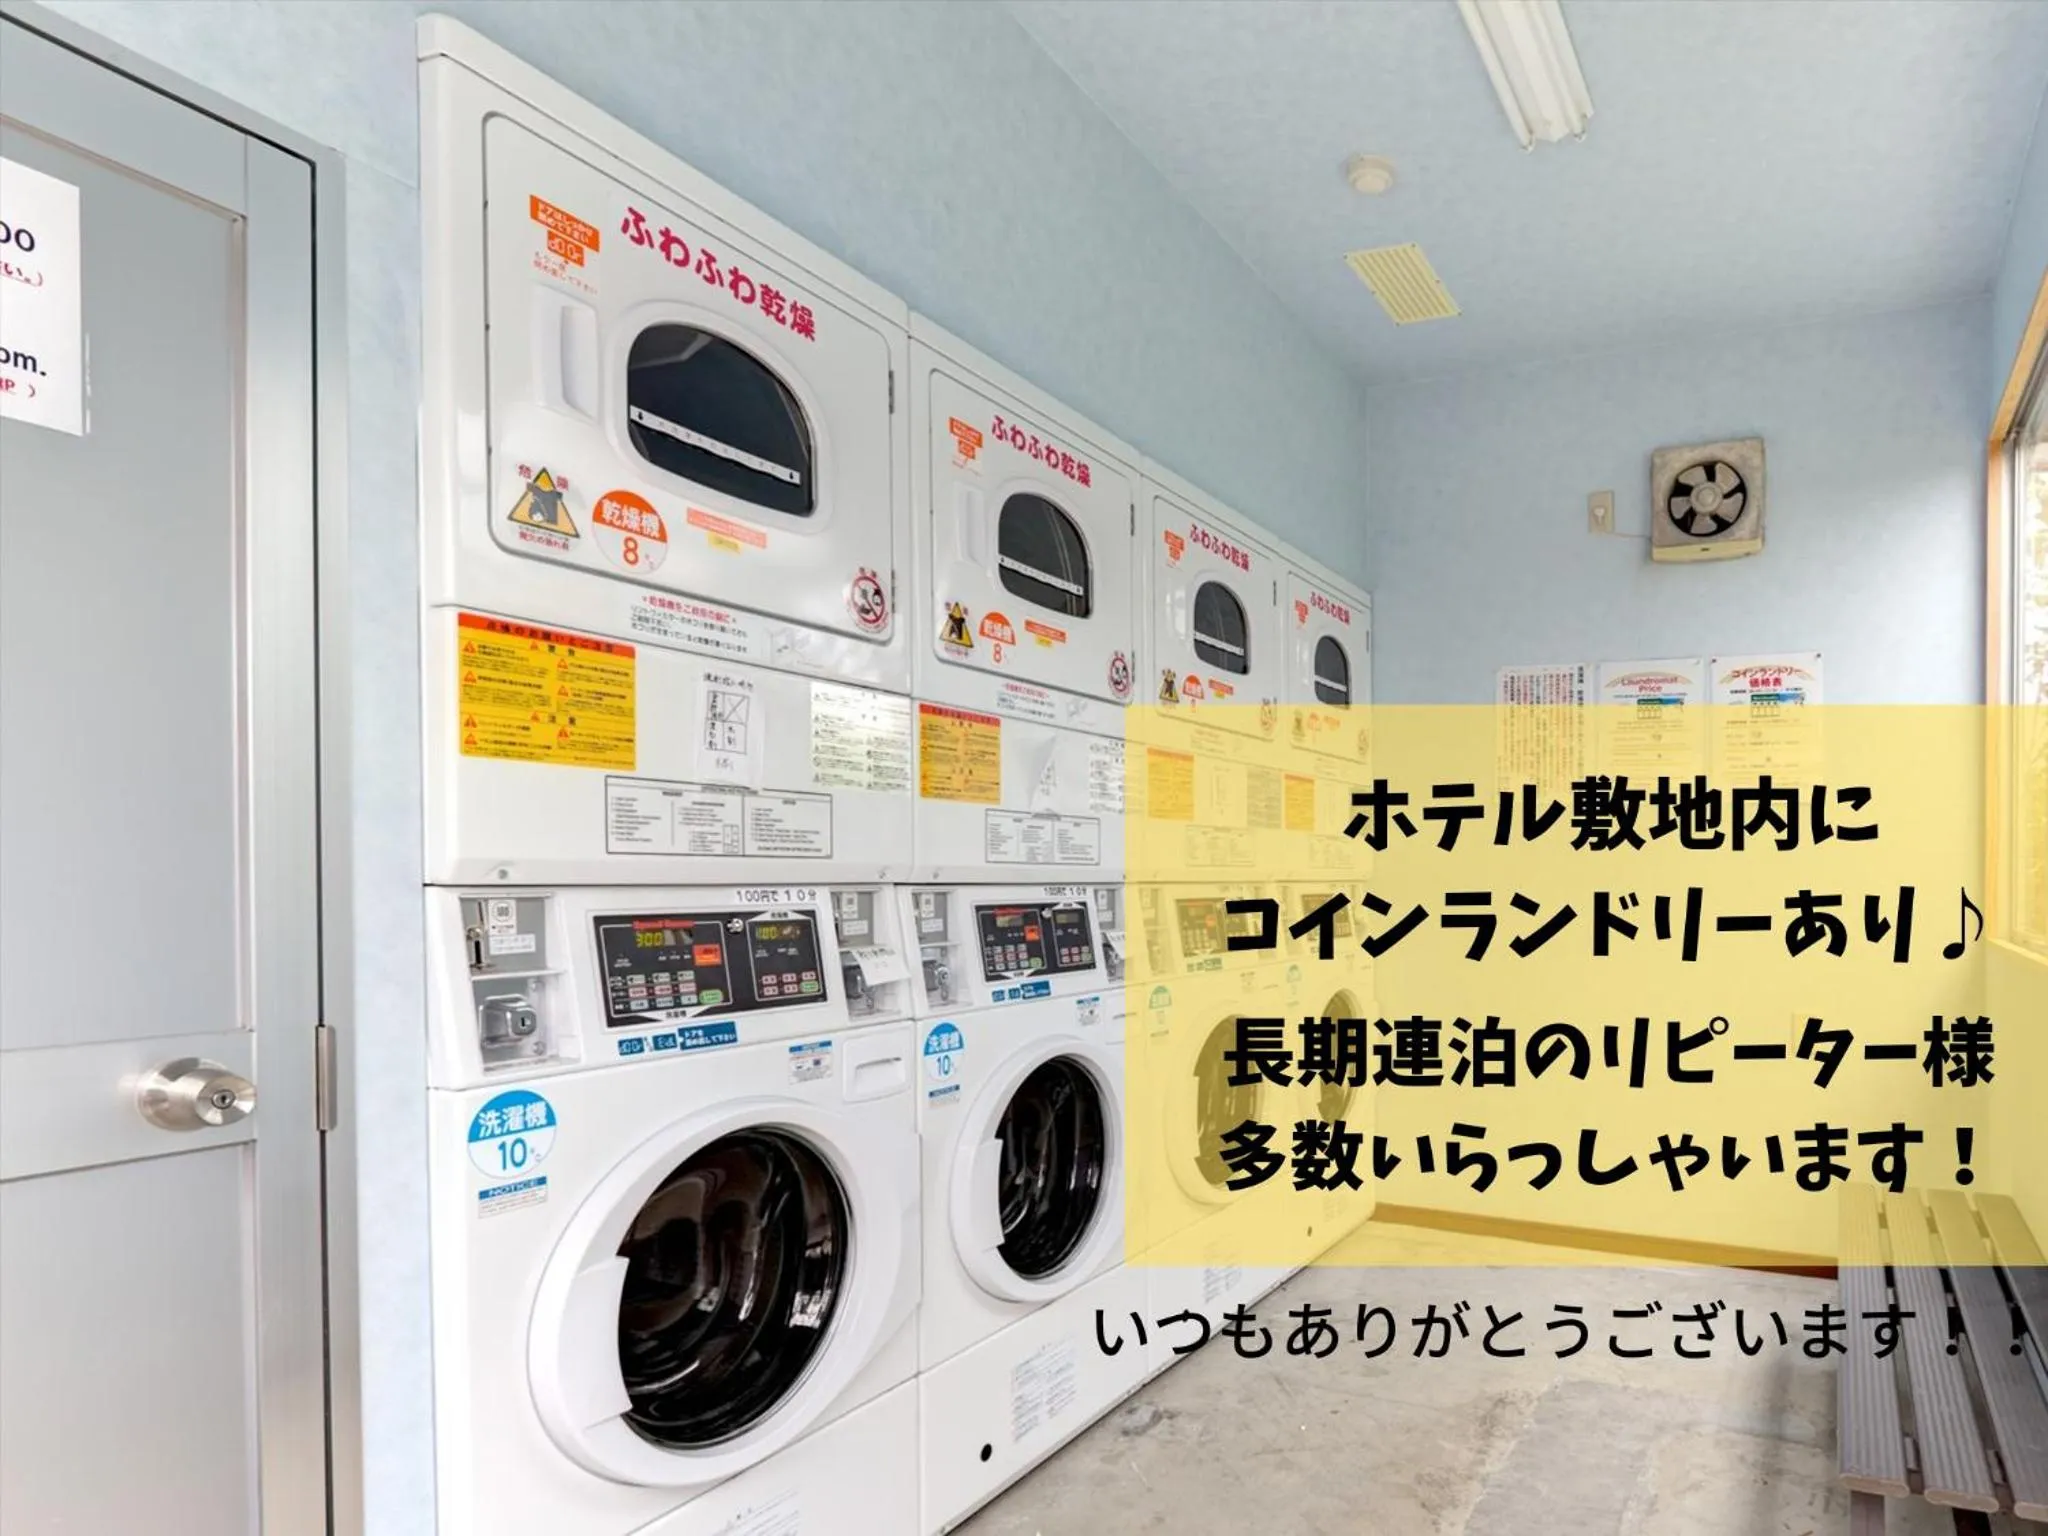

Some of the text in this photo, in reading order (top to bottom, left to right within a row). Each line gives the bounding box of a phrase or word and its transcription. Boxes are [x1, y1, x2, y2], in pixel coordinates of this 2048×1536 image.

[620, 206, 816, 342] ふわふわ乾燥
[991, 414, 1092, 488] ふわふわ乾燥
[601, 499, 660, 539] 乾燥機
[622, 535, 640, 566] 8
[1189, 523, 1250, 572] ふわふわ乾燥
[1731, 666, 1803, 679] コインランドリー
[936, 1054, 951, 1076] 10
[478, 1100, 548, 1138] 洗濯機
[497, 1136, 528, 1171] 10
